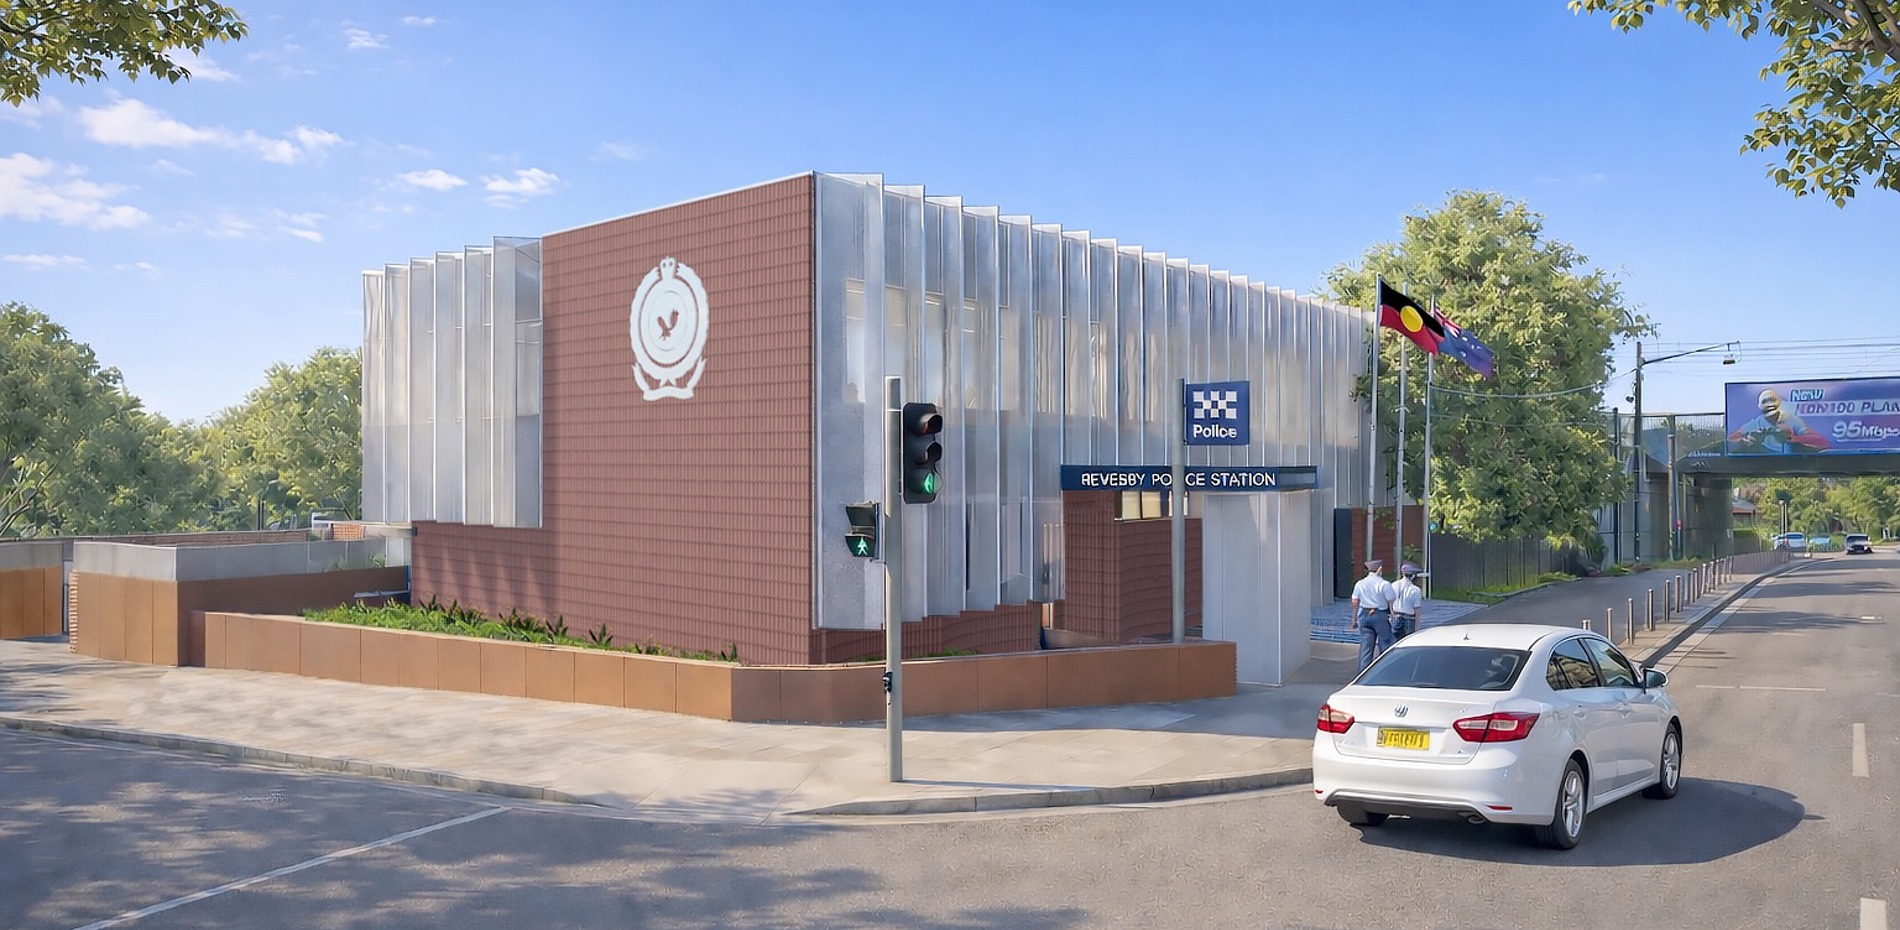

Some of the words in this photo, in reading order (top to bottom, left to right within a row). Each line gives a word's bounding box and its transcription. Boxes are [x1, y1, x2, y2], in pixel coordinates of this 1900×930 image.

[1193, 424, 1237, 438] Police
[1151, 472, 1206, 487] POCE
[1210, 472, 1276, 487] STATION
